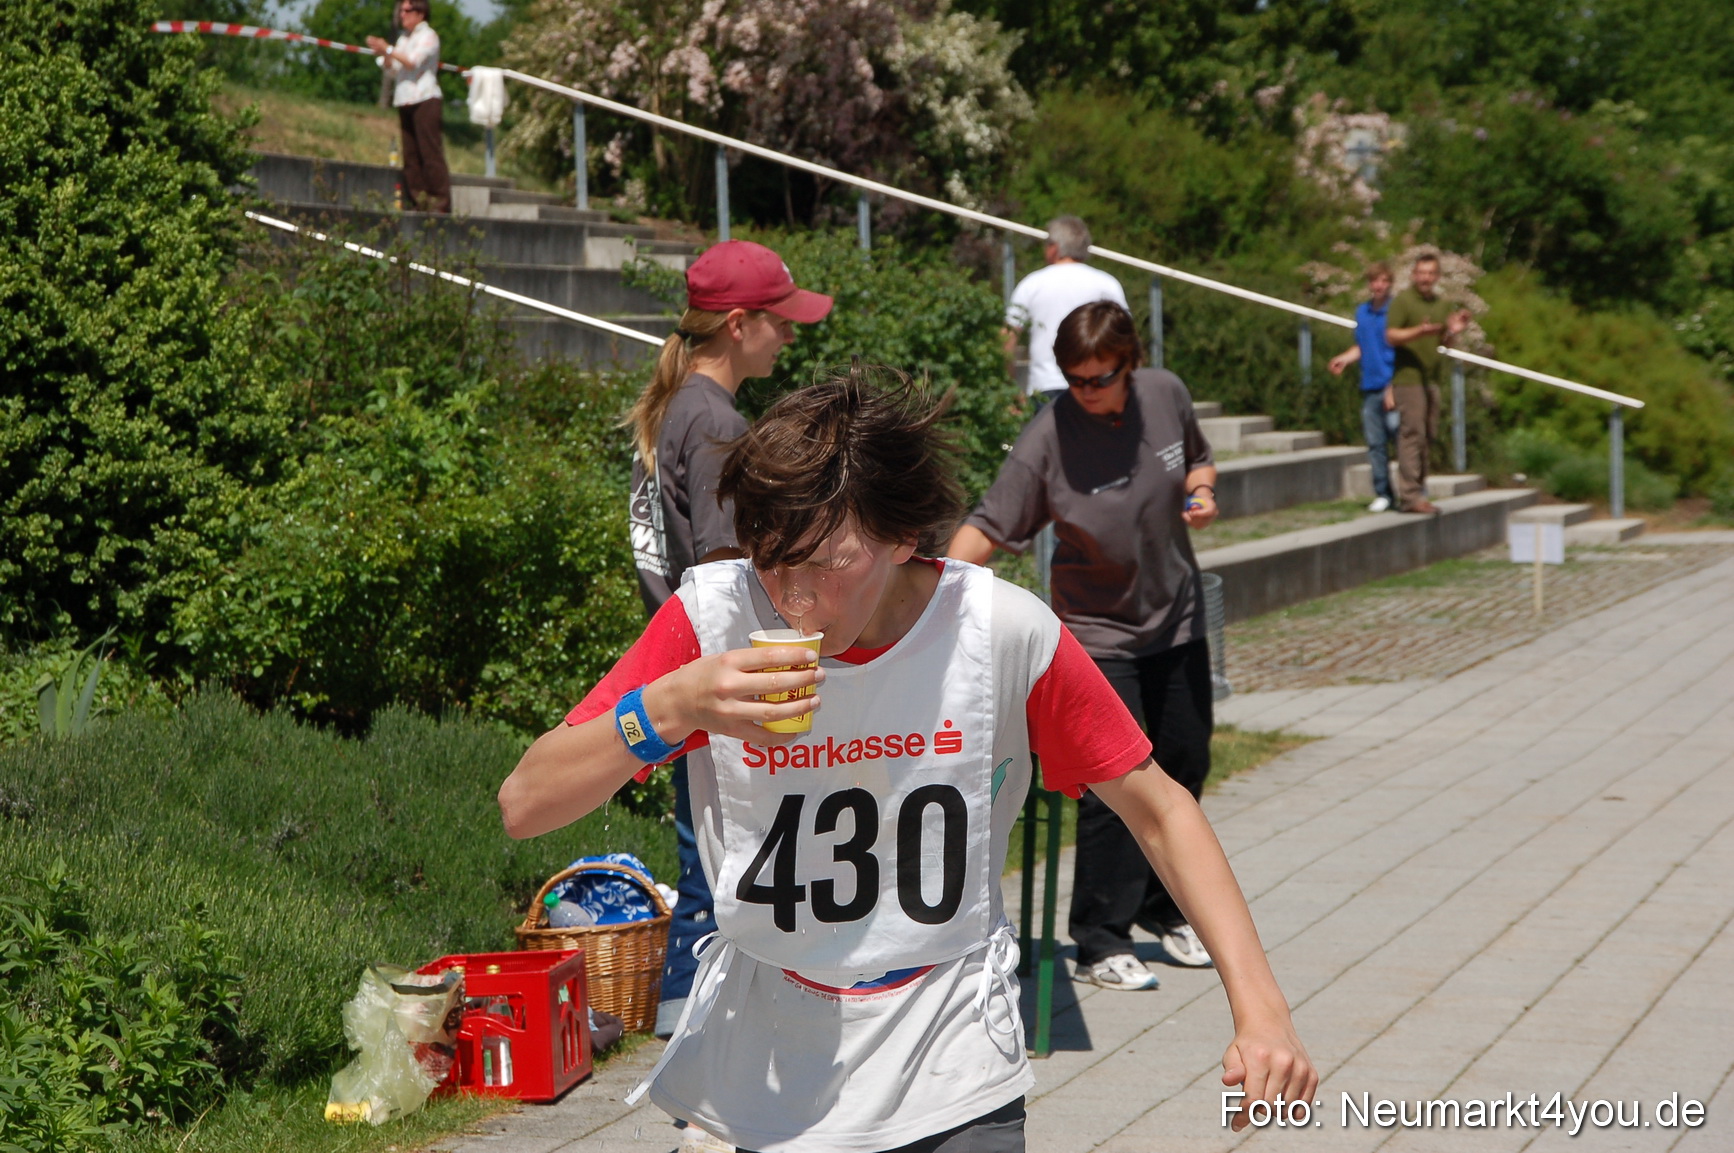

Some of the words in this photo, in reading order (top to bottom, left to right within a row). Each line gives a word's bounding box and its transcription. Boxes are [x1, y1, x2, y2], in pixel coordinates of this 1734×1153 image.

[624, 722, 640, 738] 30
[742, 733, 925, 775] Sparkasse
[736, 784, 968, 932] 430
